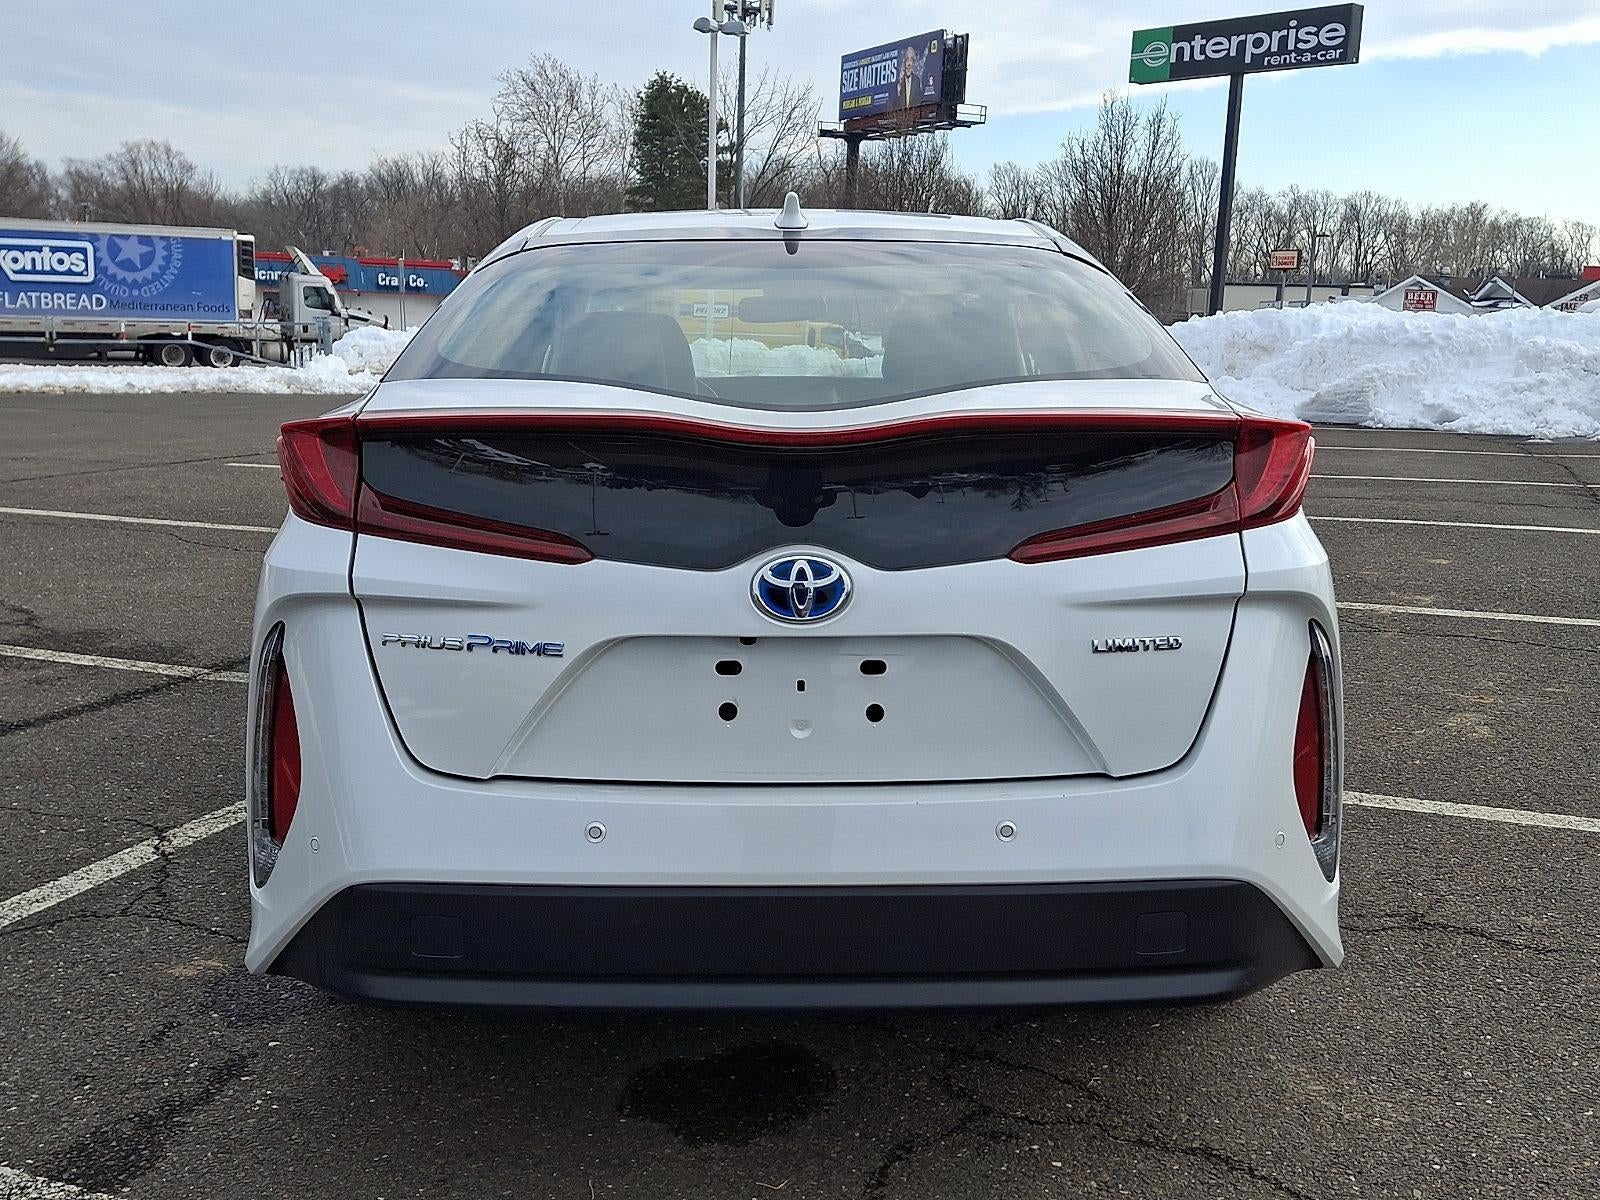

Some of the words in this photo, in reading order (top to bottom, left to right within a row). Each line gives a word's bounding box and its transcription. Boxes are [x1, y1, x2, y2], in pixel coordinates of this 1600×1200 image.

[1131, 20, 1347, 67] enterprise
[1264, 48, 1344, 66] rent-a-car
[842, 68, 859, 93] SIZE
[859, 59, 897, 89] MATTERS
[378, 272, 406, 286] Cra
[409, 274, 429, 288] Co.
[1407, 292, 1433, 301] BEER
[109, 299, 195, 312] Mediterranean
[196, 301, 231, 313] Foods
[381, 631, 465, 651] PRIUS
[466, 633, 565, 657] PRIME
[1091, 636, 1183, 653] LIMITED
